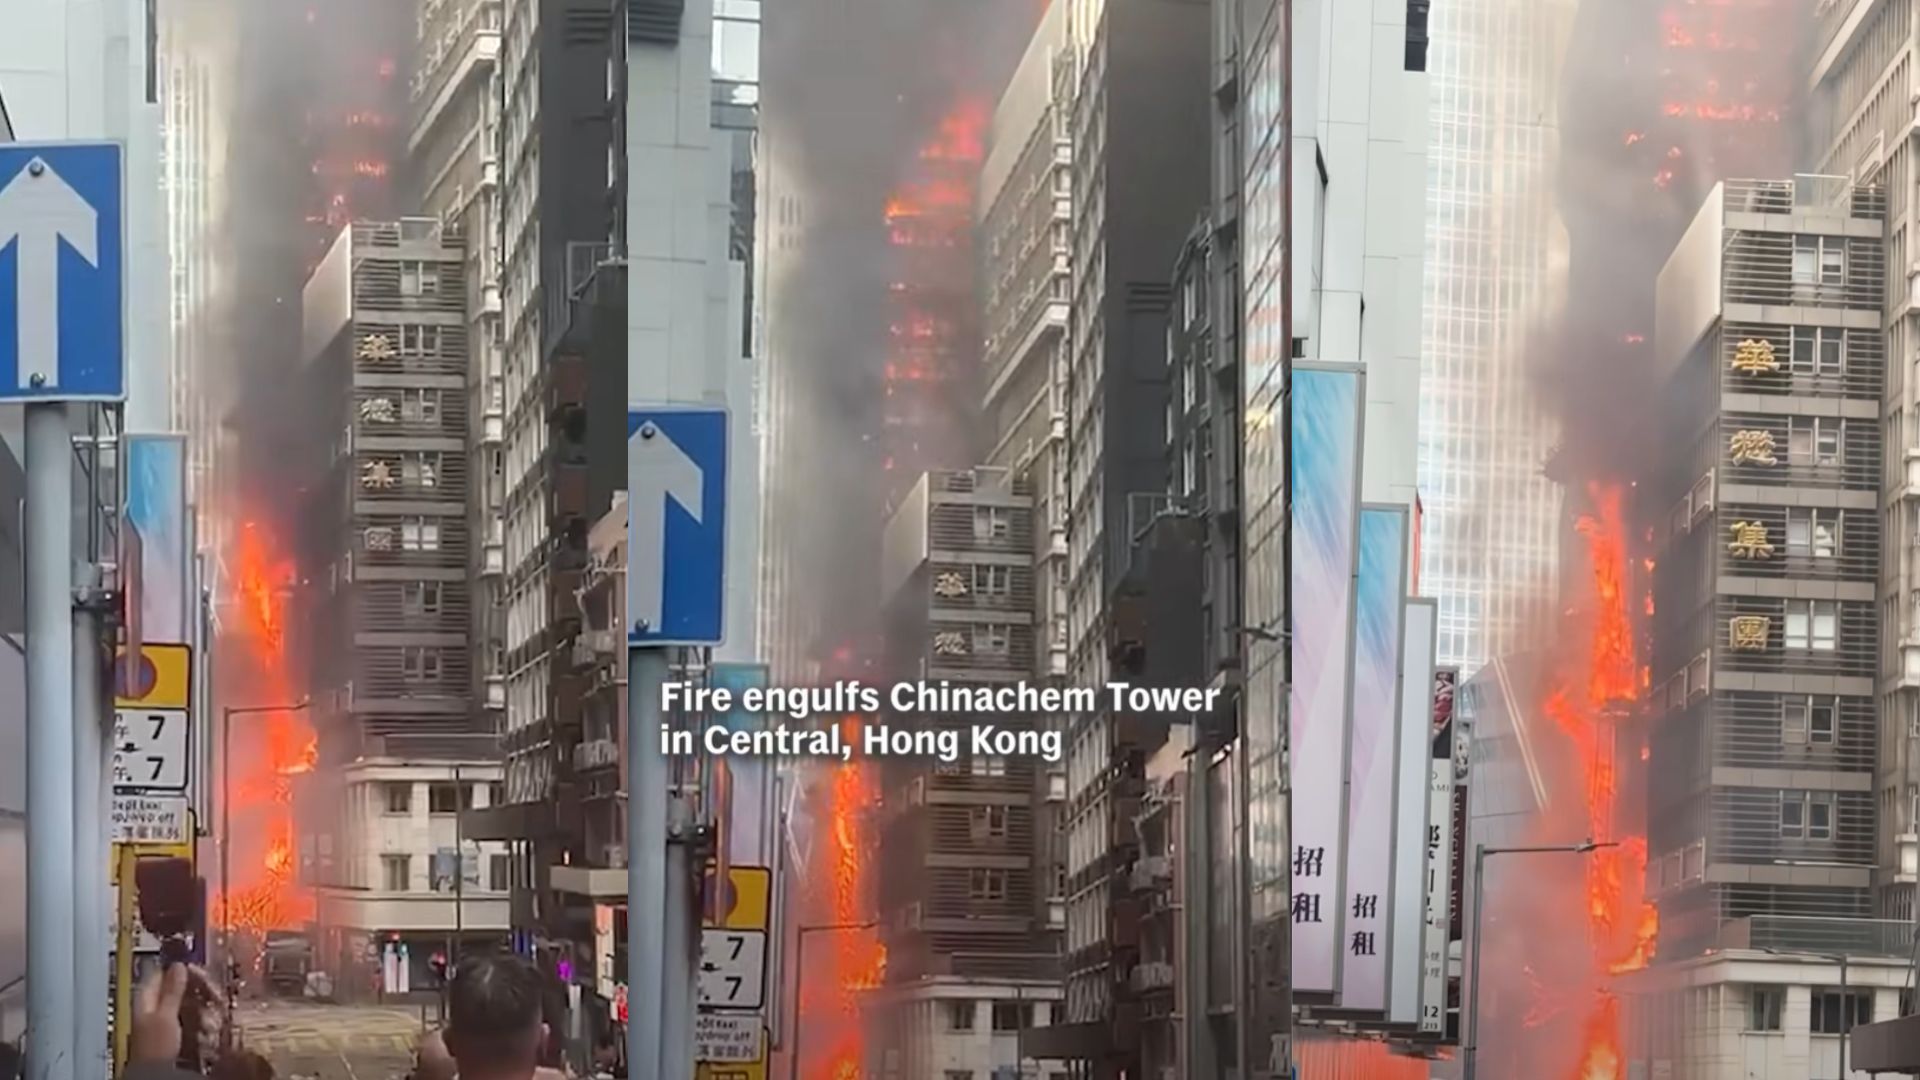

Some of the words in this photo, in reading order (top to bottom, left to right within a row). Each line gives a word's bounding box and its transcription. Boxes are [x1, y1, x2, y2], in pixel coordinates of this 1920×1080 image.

[1728, 339, 1780, 653] 華懋集團
[148, 715, 165, 740] 7
[146, 757, 164, 780] 7
[1292, 845, 1325, 923] 招租
[1351, 893, 1377, 956] 招租
[727, 936, 744, 960] 7
[725, 976, 742, 1000] 7
